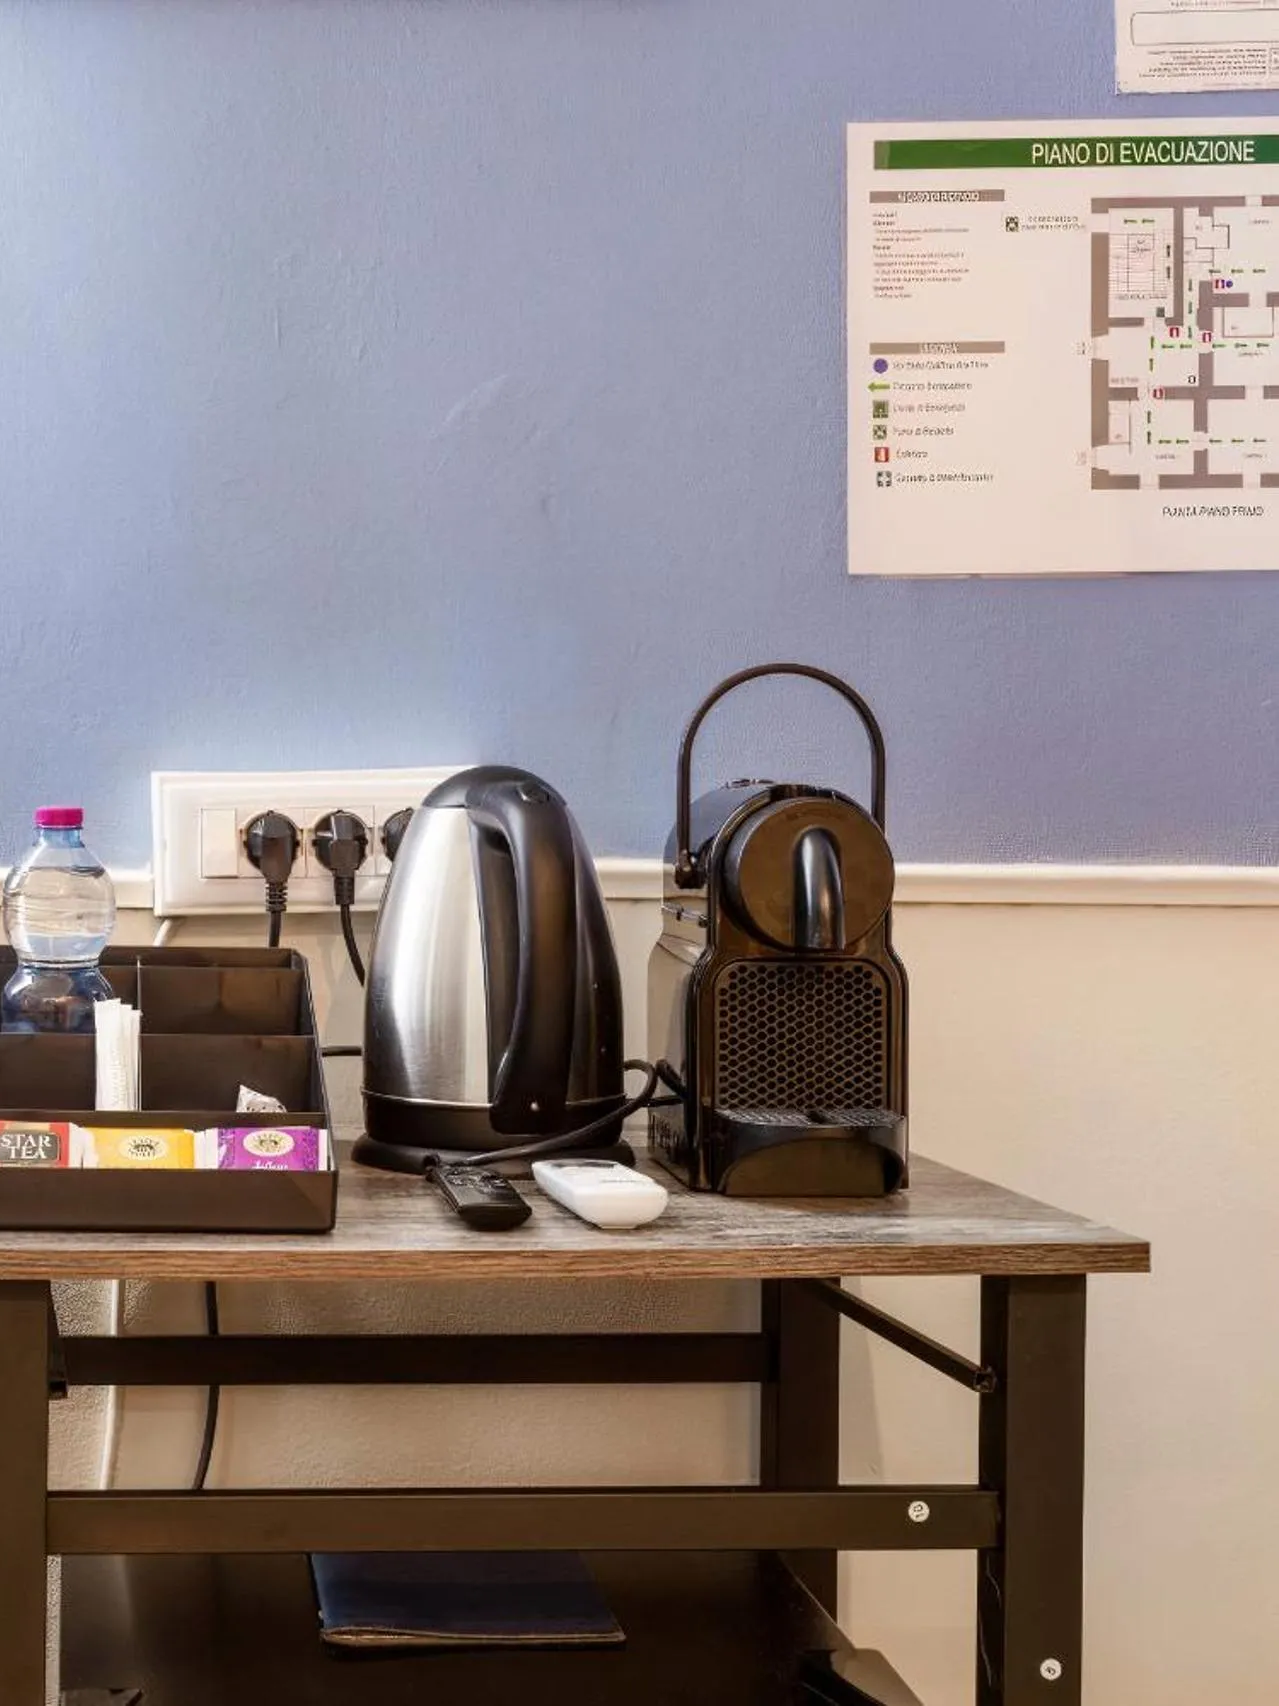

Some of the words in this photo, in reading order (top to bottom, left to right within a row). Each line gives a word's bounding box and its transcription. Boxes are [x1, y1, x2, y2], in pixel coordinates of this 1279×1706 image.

[1031, 142, 1090, 165] PIANO
[1096, 142, 1115, 164] DI
[1120, 140, 1256, 163] EVACUAZIONE
[0, 1133, 52, 1149] STAR
[7, 1145, 47, 1160] TEA
